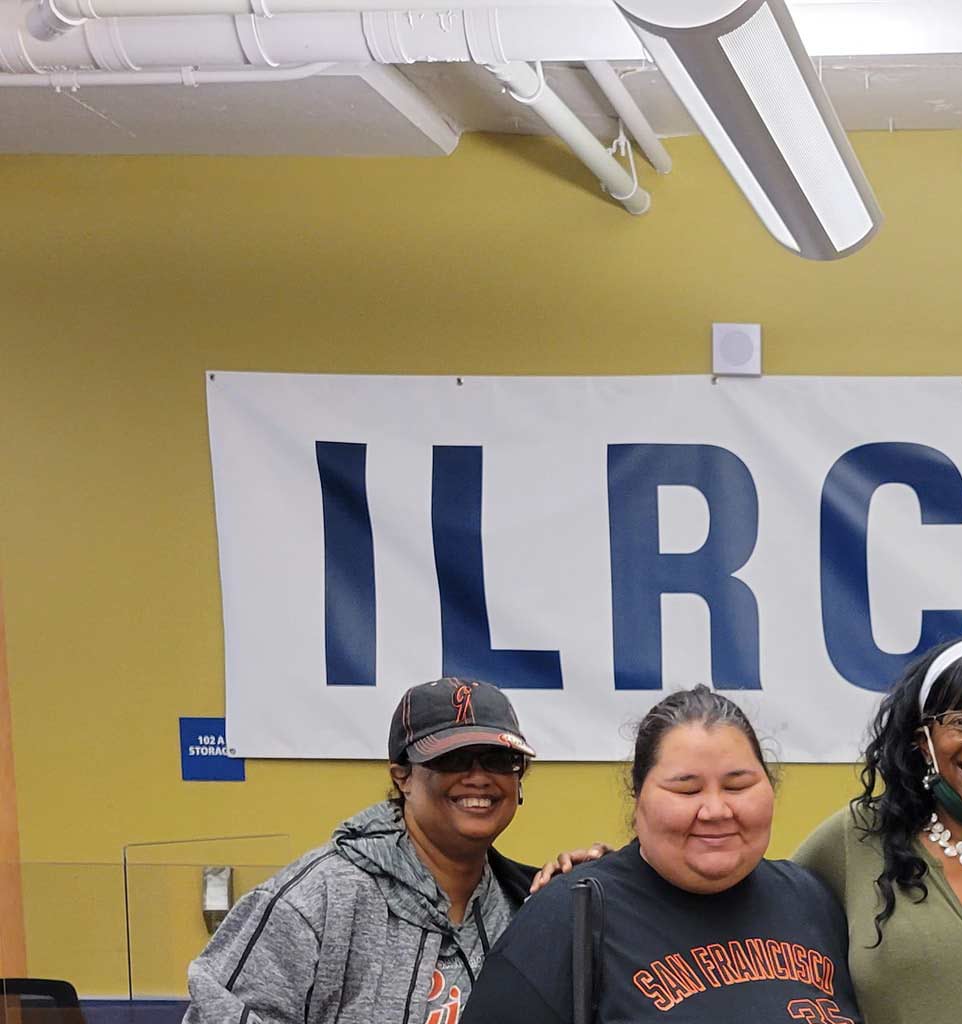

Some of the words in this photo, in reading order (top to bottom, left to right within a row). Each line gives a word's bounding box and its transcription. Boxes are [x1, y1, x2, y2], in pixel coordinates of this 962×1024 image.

[197, 735, 216, 745] 102
[217, 735, 225, 745] A
[188, 746, 229, 756] STORAG
[633, 953, 706, 1012] SAN
[691, 938, 834, 997] FRANCISCO
